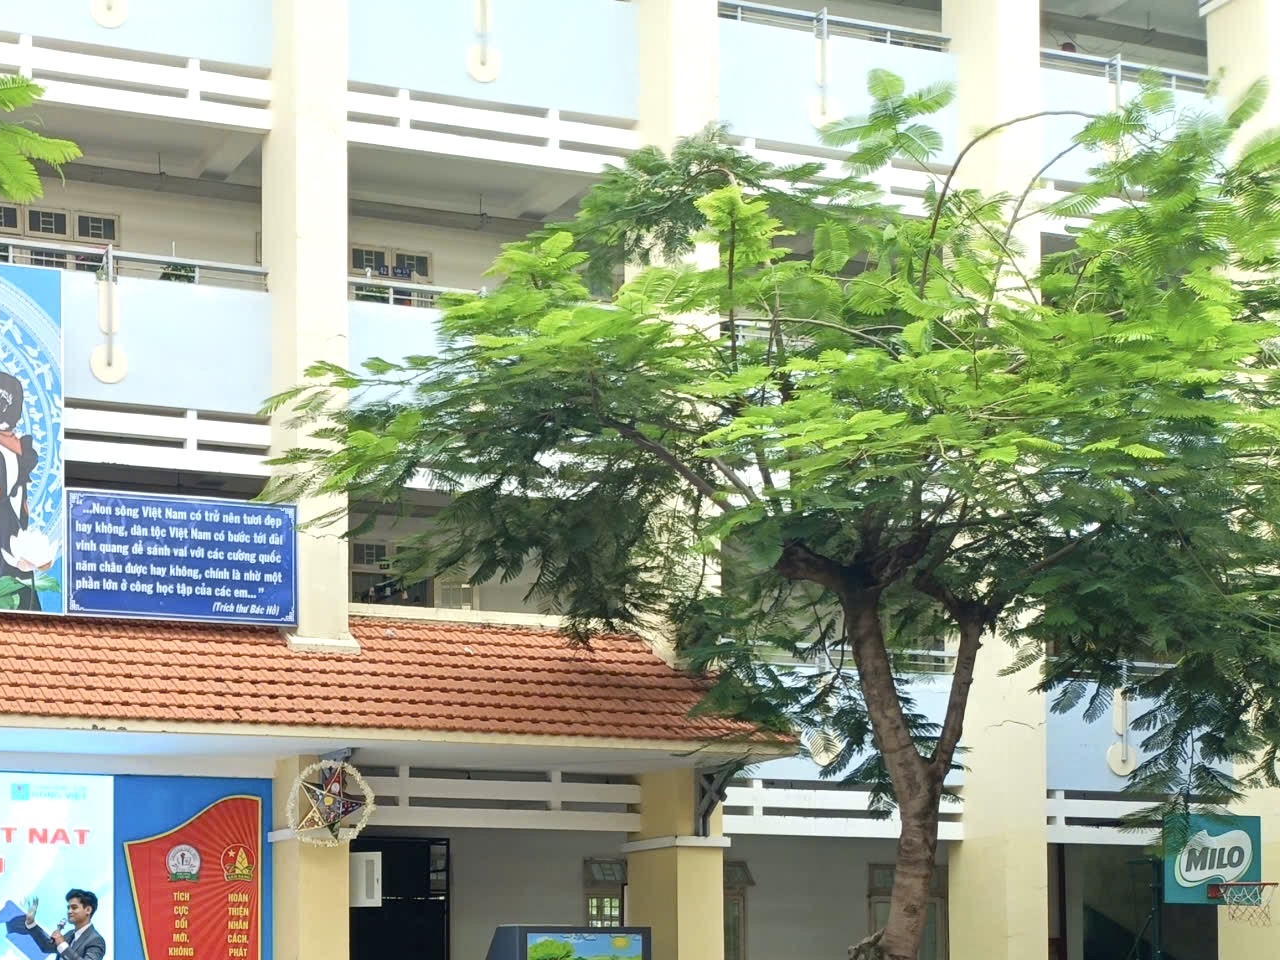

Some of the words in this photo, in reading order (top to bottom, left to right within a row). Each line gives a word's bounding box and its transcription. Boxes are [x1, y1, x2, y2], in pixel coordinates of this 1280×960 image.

[115, 505, 139, 519] sông
[142, 506, 162, 521] Việt
[165, 508, 187, 520] Nam
[190, 509, 202, 521] có
[205, 509, 220, 522] trở
[223, 512, 241, 524] nên
[243, 513, 262, 525] tươi
[264, 514, 282, 528] đẹp
[75, 520, 92, 534] hay
[95, 522, 128, 537] không,
[131, 524, 149, 537] dân
[151, 526, 167, 540] tộc
[169, 526, 188, 541] Việt
[191, 528, 212, 540] Nam
[214, 530, 225, 541] có
[228, 531, 250, 543] bước
[253, 532, 266, 544] tới
[269, 533, 283, 545] đài
[76, 540, 97, 552] vinh
[100, 543, 129, 556] quang
[132, 540, 144, 555] để
[147, 544, 170, 557] sánh
[173, 546, 188, 557] vai
[190, 547, 205, 558] với
[207, 548, 225, 560] các
[259, 550, 282, 564] quốc
[75, 560, 97, 572] năm
[99, 561, 122, 573] châu
[125, 562, 148, 577] được
[150, 563, 167, 578] hay
[170, 564, 202, 580] không,
[204, 567, 230, 580] chính
[232, 568, 241, 580] là
[243, 569, 261, 582] nhờ
[264, 571, 282, 585] một
[75, 576, 100, 591] phần
[103, 578, 118, 590] lớn
[120, 579, 128, 591] ở
[130, 580, 154, 595] công
[156, 581, 174, 596] học
[176, 582, 193, 597] tập
[195, 582, 212, 596] của
[214, 585, 232, 597] các
[1185, 845, 1245, 872] MILO
[173, 891, 190, 902] TÍCH
